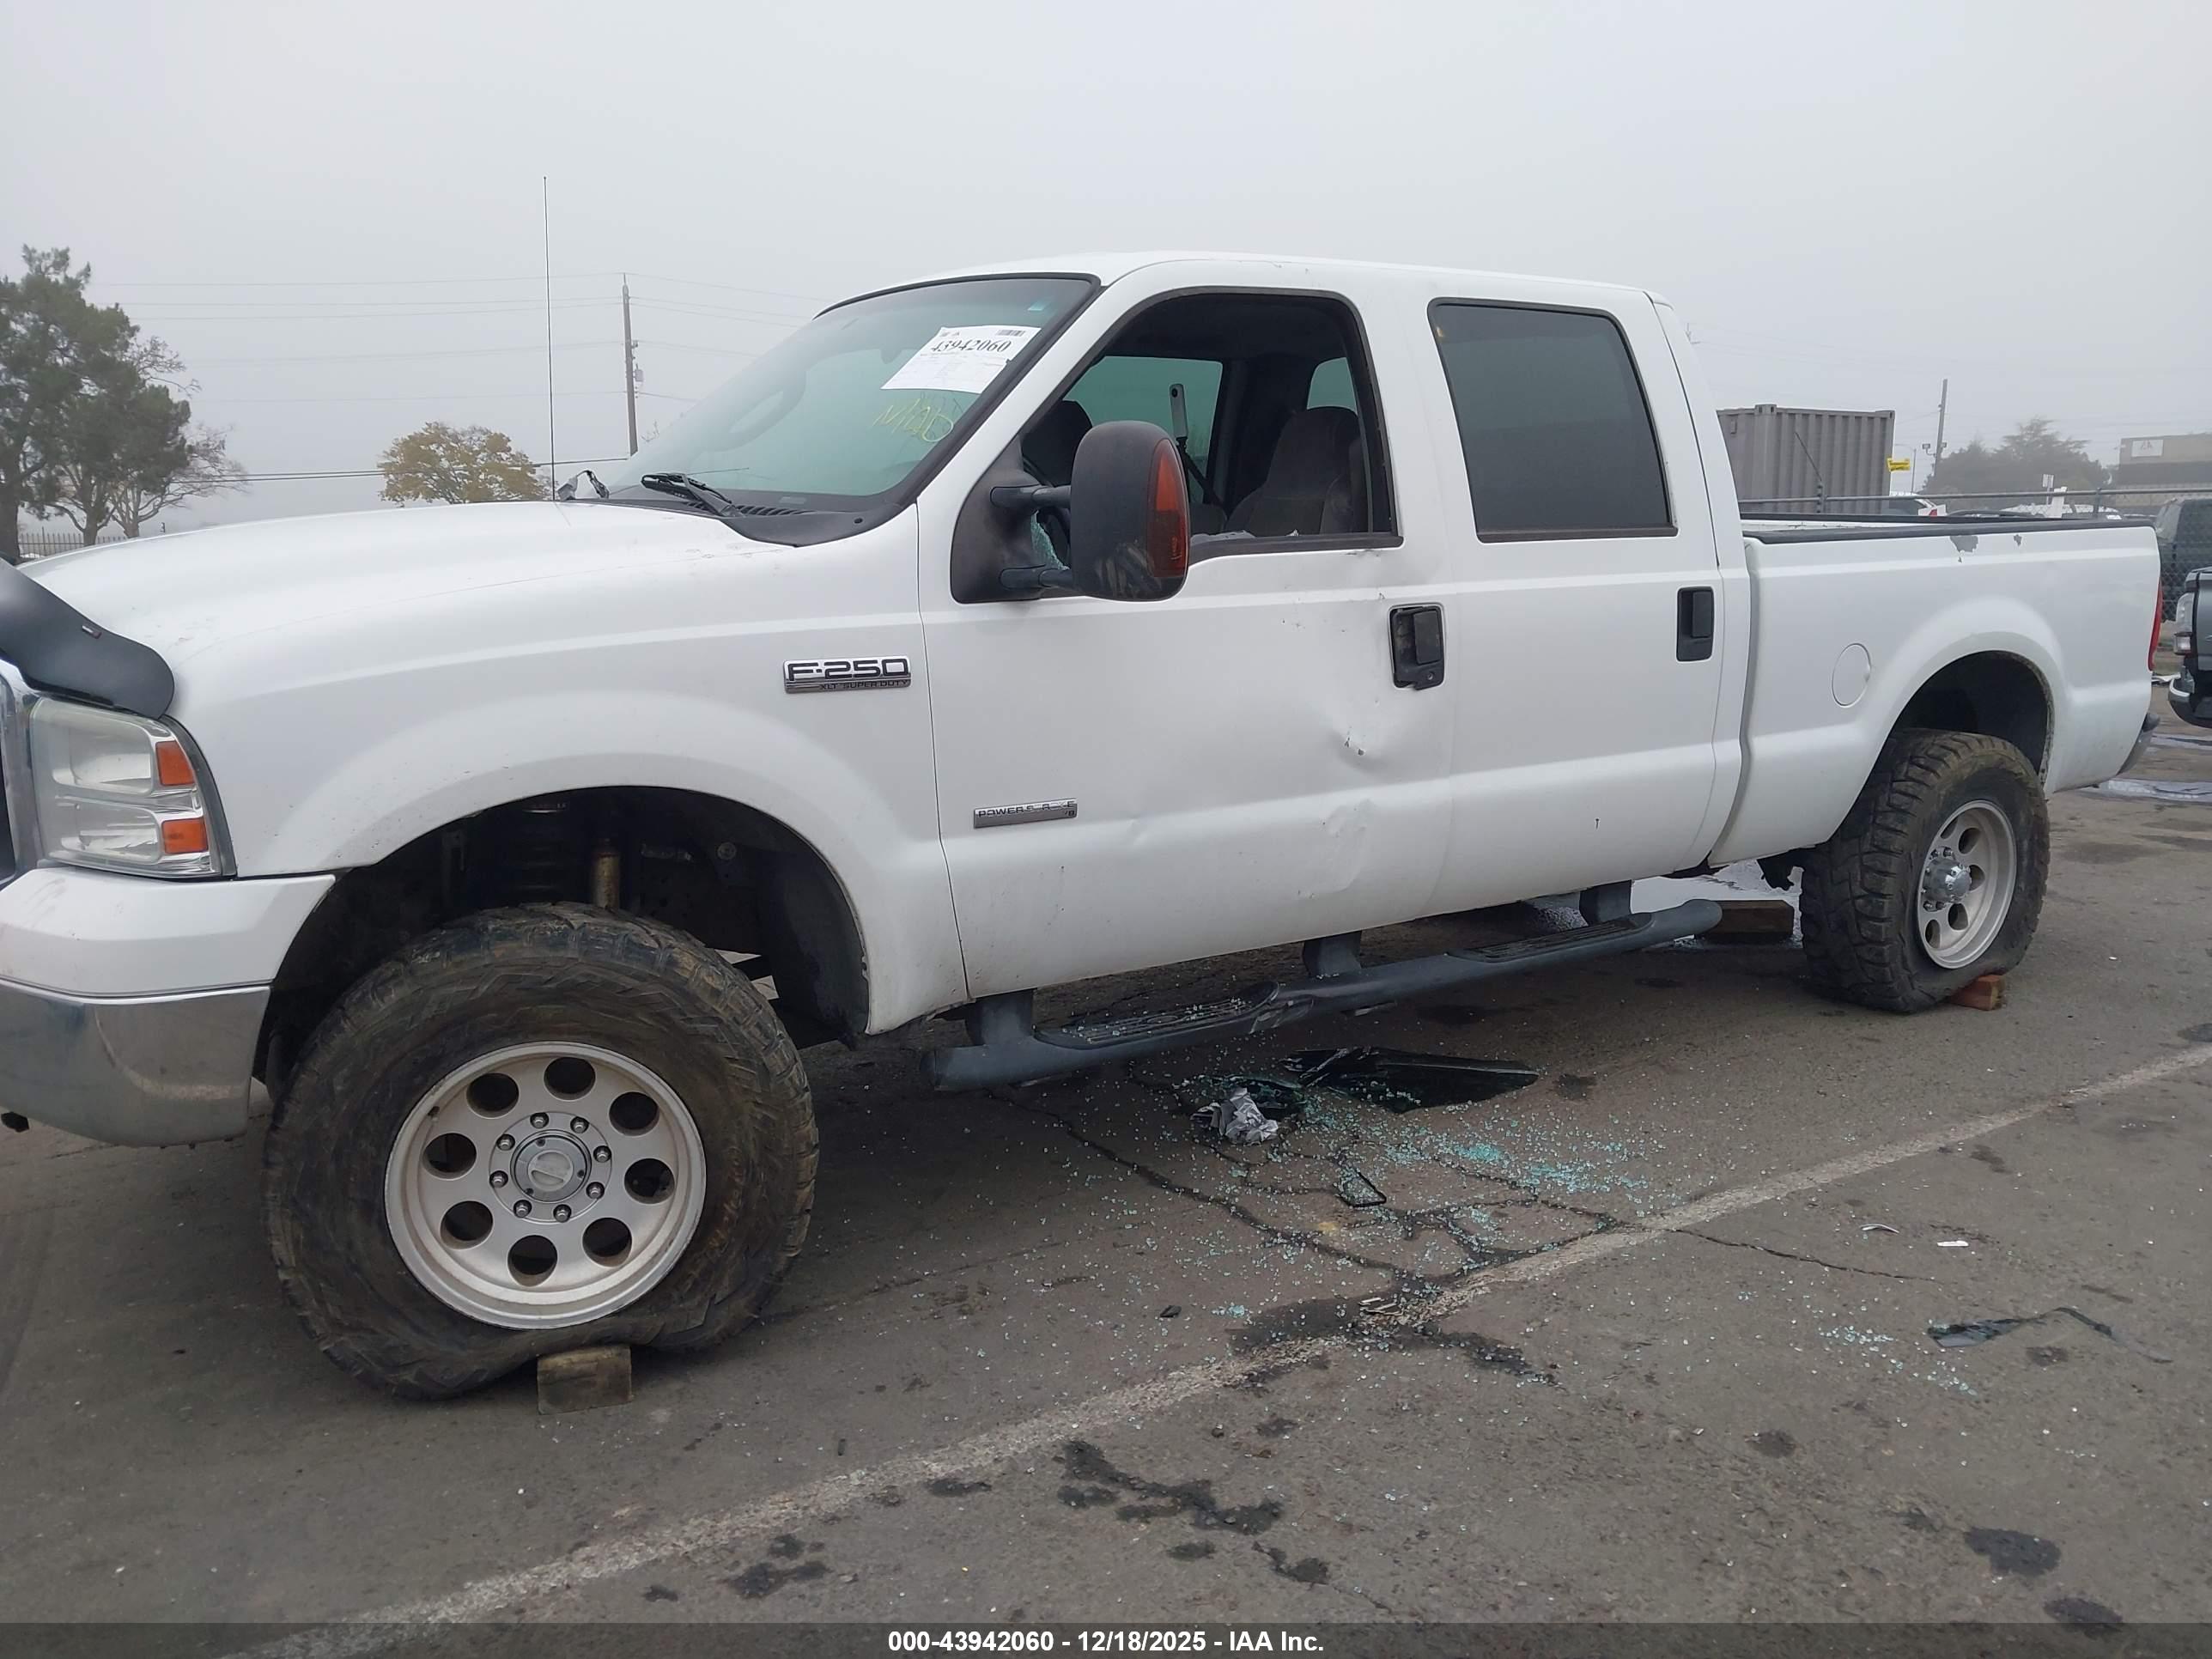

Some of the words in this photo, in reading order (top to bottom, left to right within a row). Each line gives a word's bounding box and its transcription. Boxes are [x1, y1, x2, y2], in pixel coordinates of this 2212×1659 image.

[930, 339, 1012, 353] 43942060
[787, 658, 909, 682] F-250
[880, 679, 908, 688] DUTY
